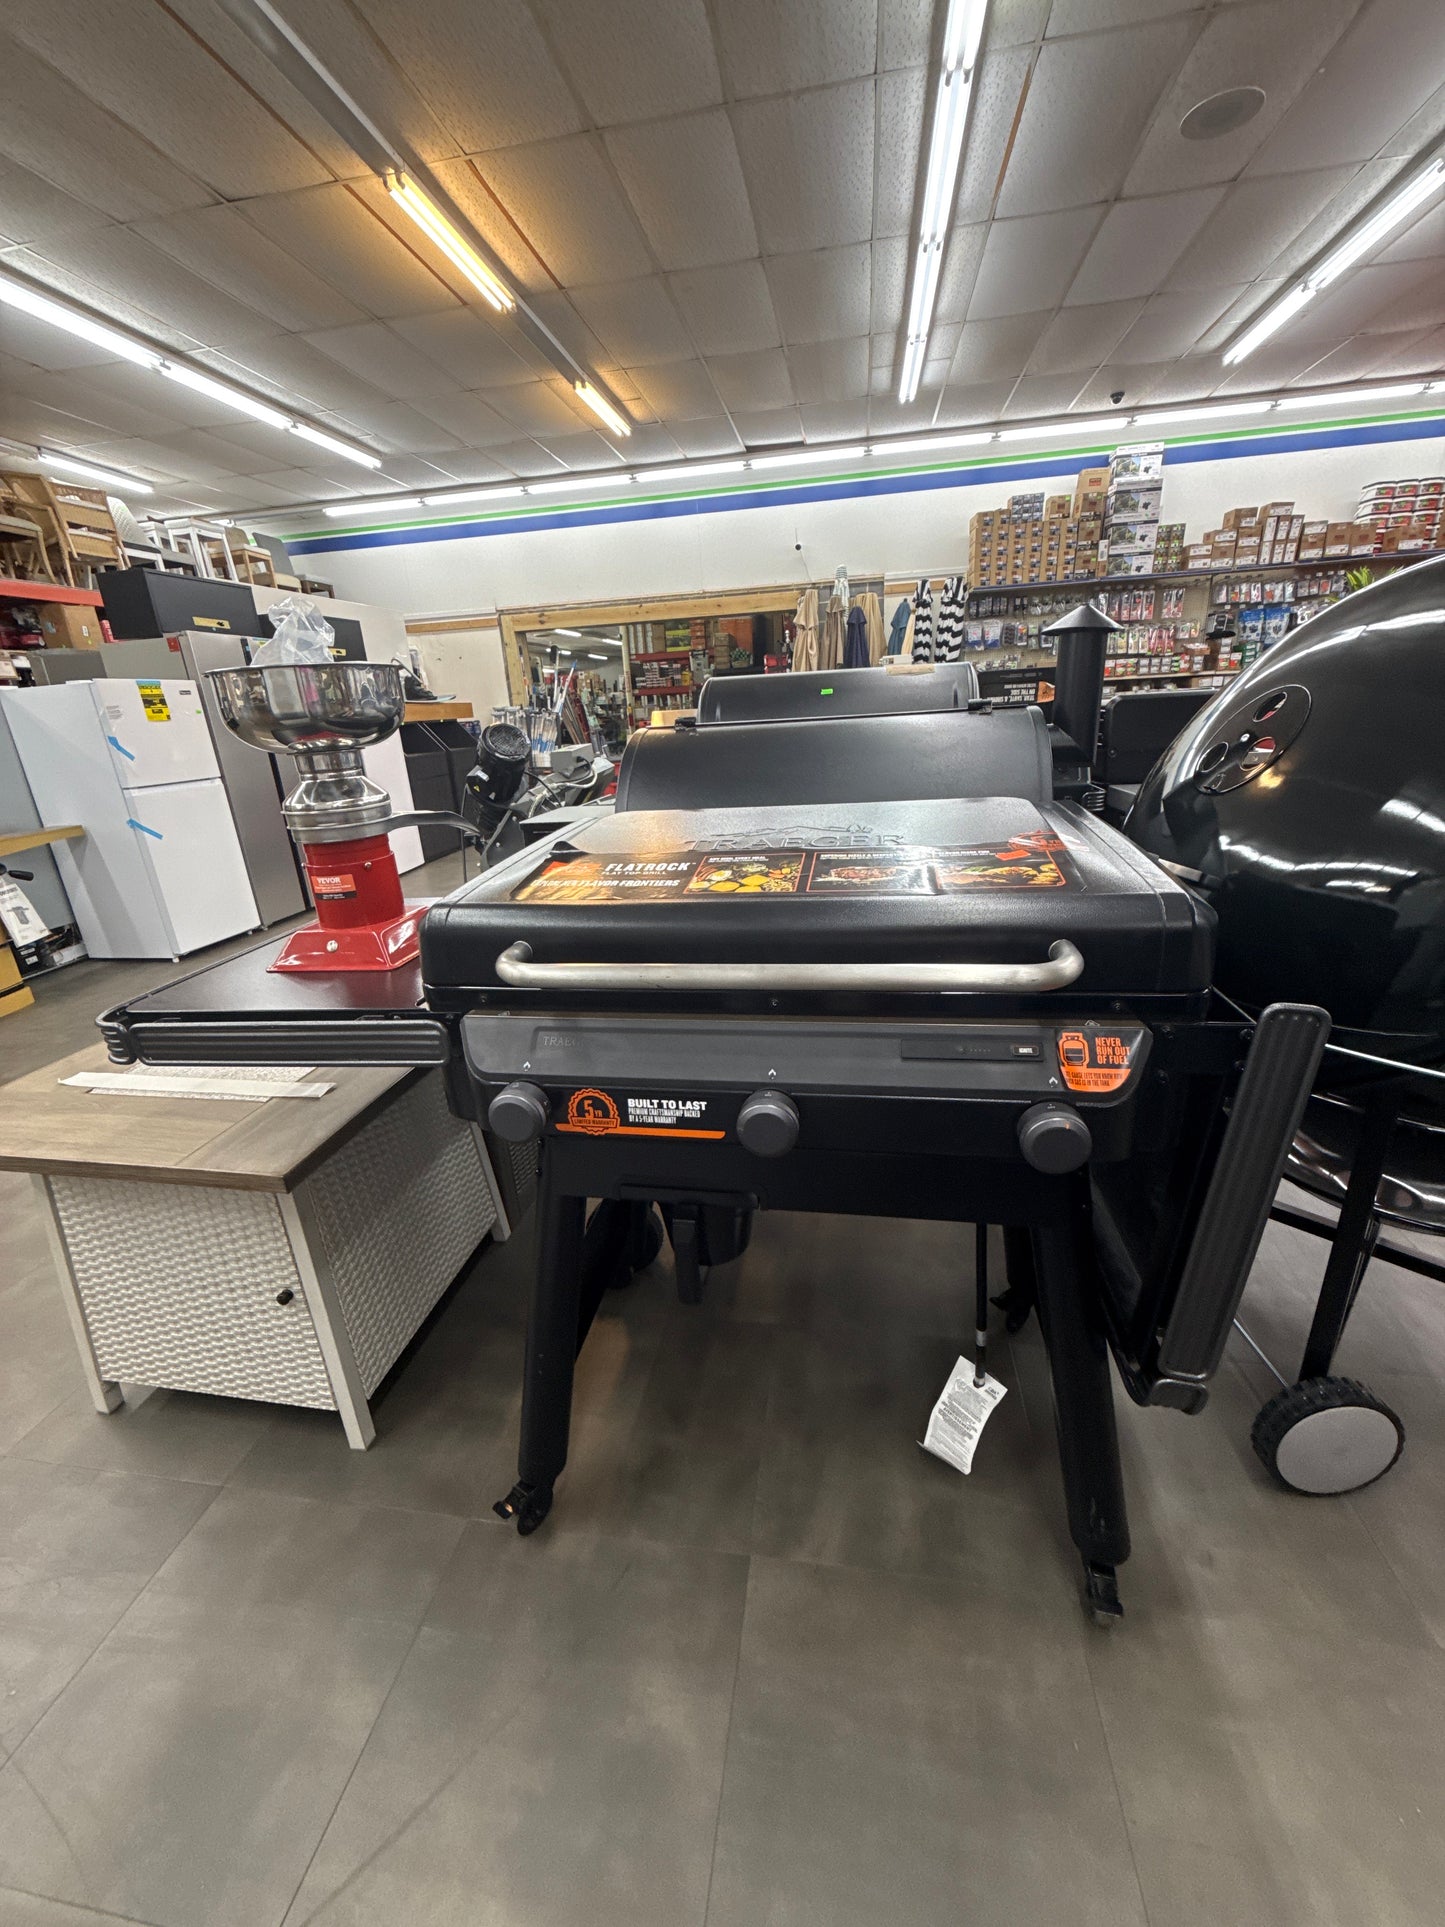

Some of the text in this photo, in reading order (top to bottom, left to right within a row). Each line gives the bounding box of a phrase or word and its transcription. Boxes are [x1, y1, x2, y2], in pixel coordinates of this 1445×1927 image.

[685, 834, 905, 851] TRAEGER
[605, 862, 690, 872] FLATROCK
[316, 876, 341, 884] VEVOR
[580, 879, 618, 888] FLAVOR
[619, 879, 681, 887] FRONTIERS
[1095, 1037, 1121, 1047] NEVER
[1096, 1046, 1131, 1056] RUN OUT
[1097, 1055, 1129, 1065] OF FUEL
[583, 1099, 594, 1119] 5
[627, 1098, 707, 1111] BUILT TO LAST
[628, 1107, 649, 1116] PREMIUM
[648, 1109, 684, 1117] CRAFTSMANSHIP
